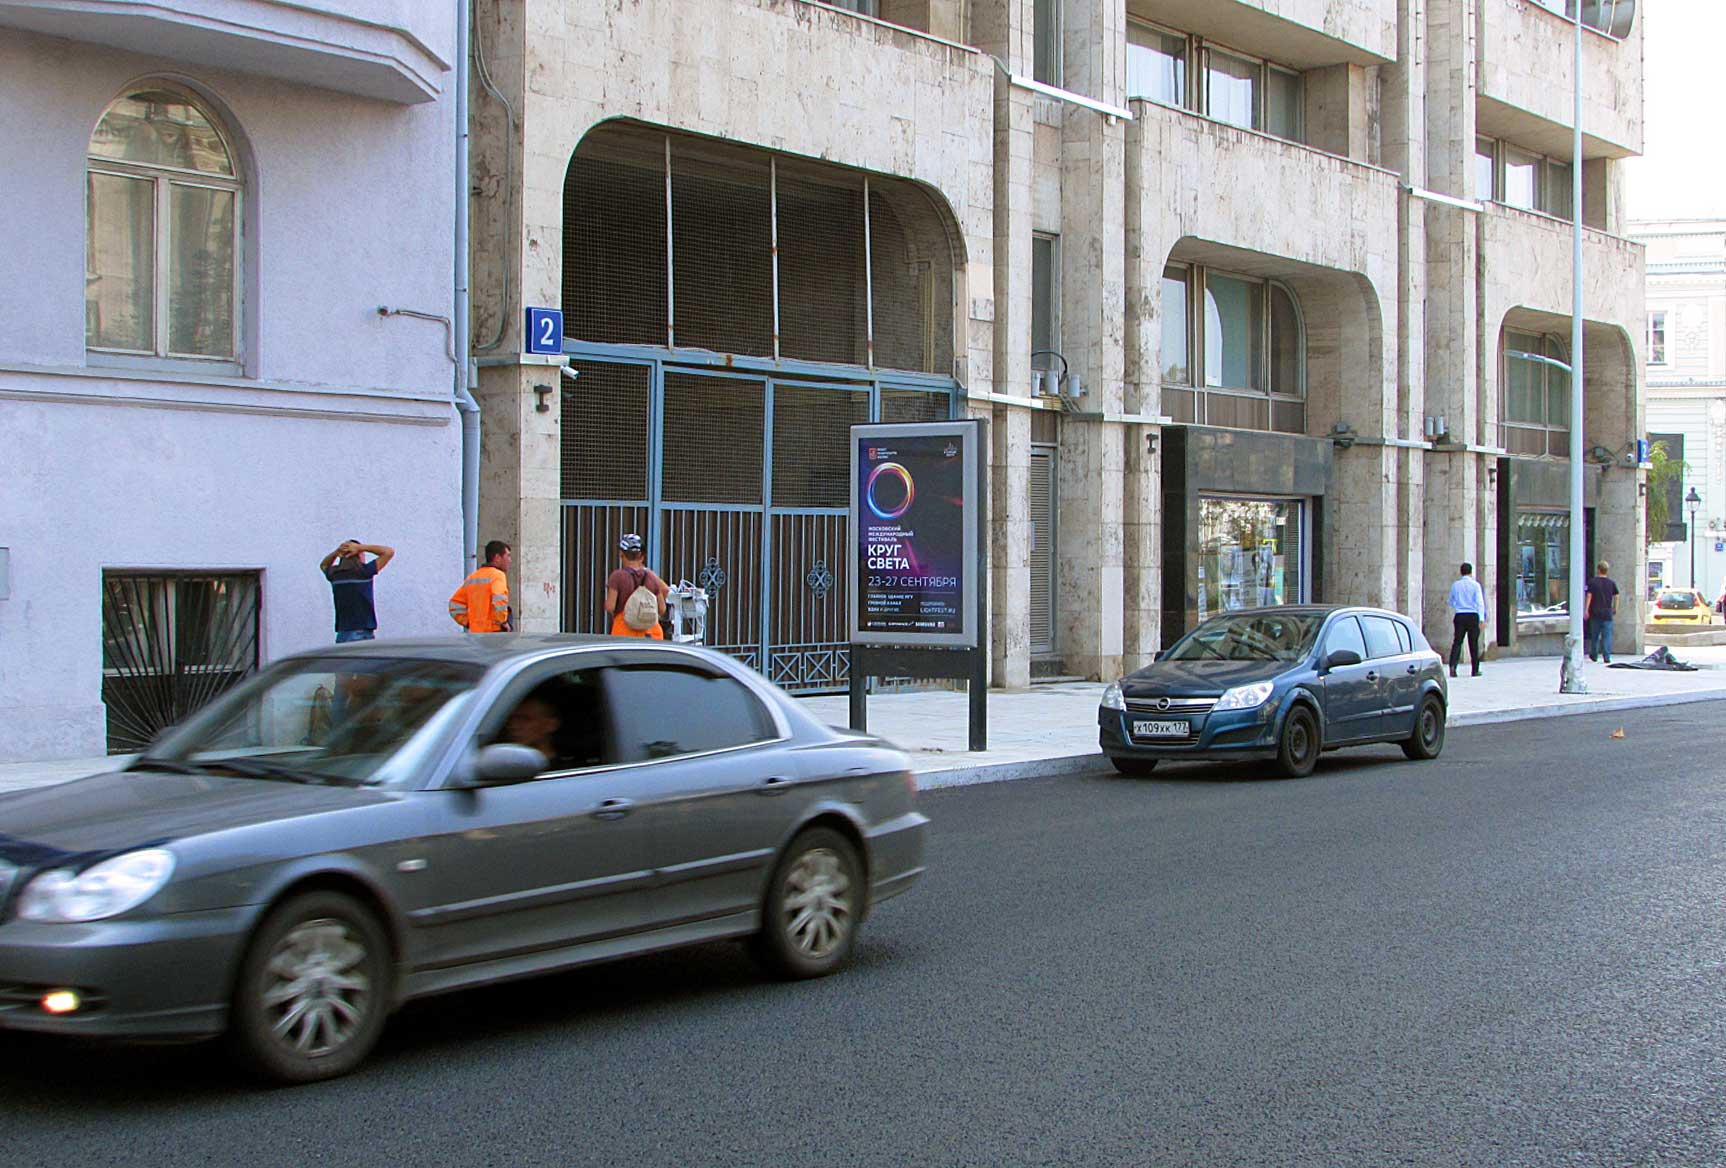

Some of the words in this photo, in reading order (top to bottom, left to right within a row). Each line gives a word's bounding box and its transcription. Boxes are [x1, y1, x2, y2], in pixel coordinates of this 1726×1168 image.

[540, 317, 554, 346] 2
[867, 544, 902, 557] КРУГ
[867, 557, 910, 570] СВЕТА
[868, 576, 898, 587] 23-27
[900, 576, 957, 588] СЕНТЯБРЯ
[1173, 722, 1187, 731] 177
